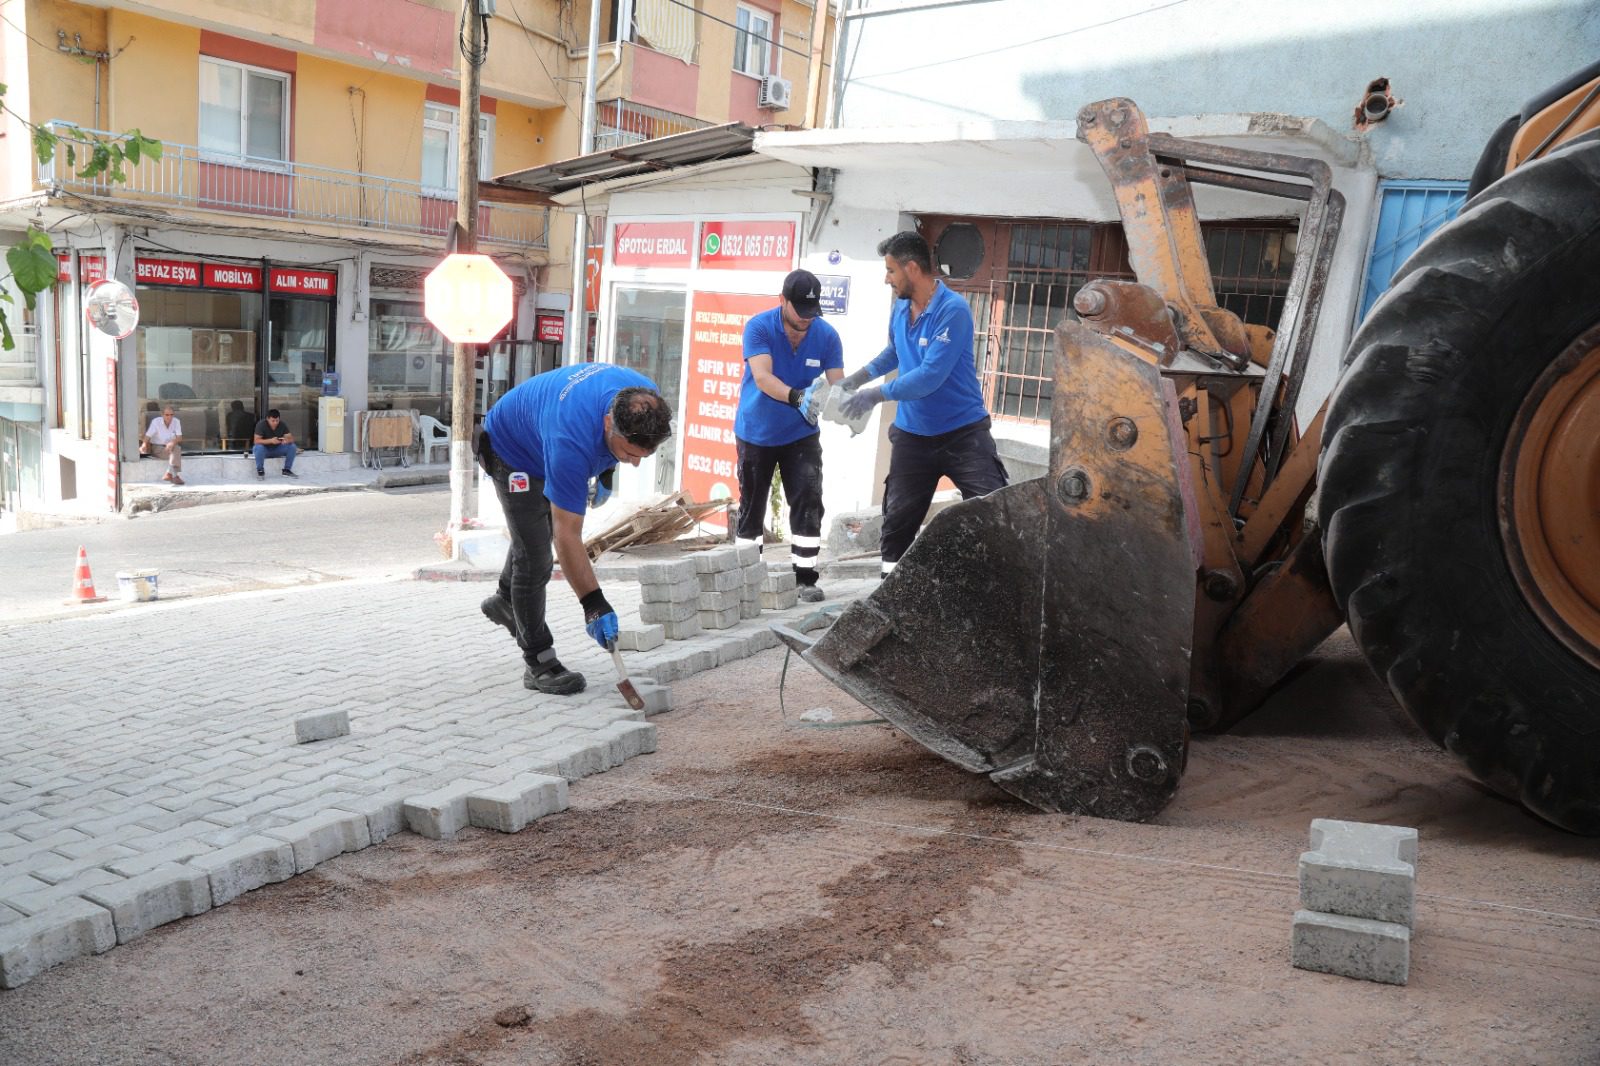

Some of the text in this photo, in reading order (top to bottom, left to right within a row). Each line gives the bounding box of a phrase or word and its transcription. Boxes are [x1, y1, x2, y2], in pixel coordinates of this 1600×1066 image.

[619, 237, 687, 255] SPOTCU ERDAL
[721, 234, 788, 257] 0532 065 67 83
[138, 263, 197, 282] BEYAZ EŞYA
[214, 268, 253, 284] MOBİLYA
[276, 274, 297, 288] ALIM
[303, 276, 328, 290] SATIM
[697, 358, 724, 376] SIFIR
[726, 361, 741, 377] VE
[703, 379, 741, 400] EV EŞY
[698, 400, 737, 421] DEĞERİ
[687, 423, 737, 445] ALINIR SA
[687, 453, 711, 474] 0532
[713, 458, 732, 478] 065
